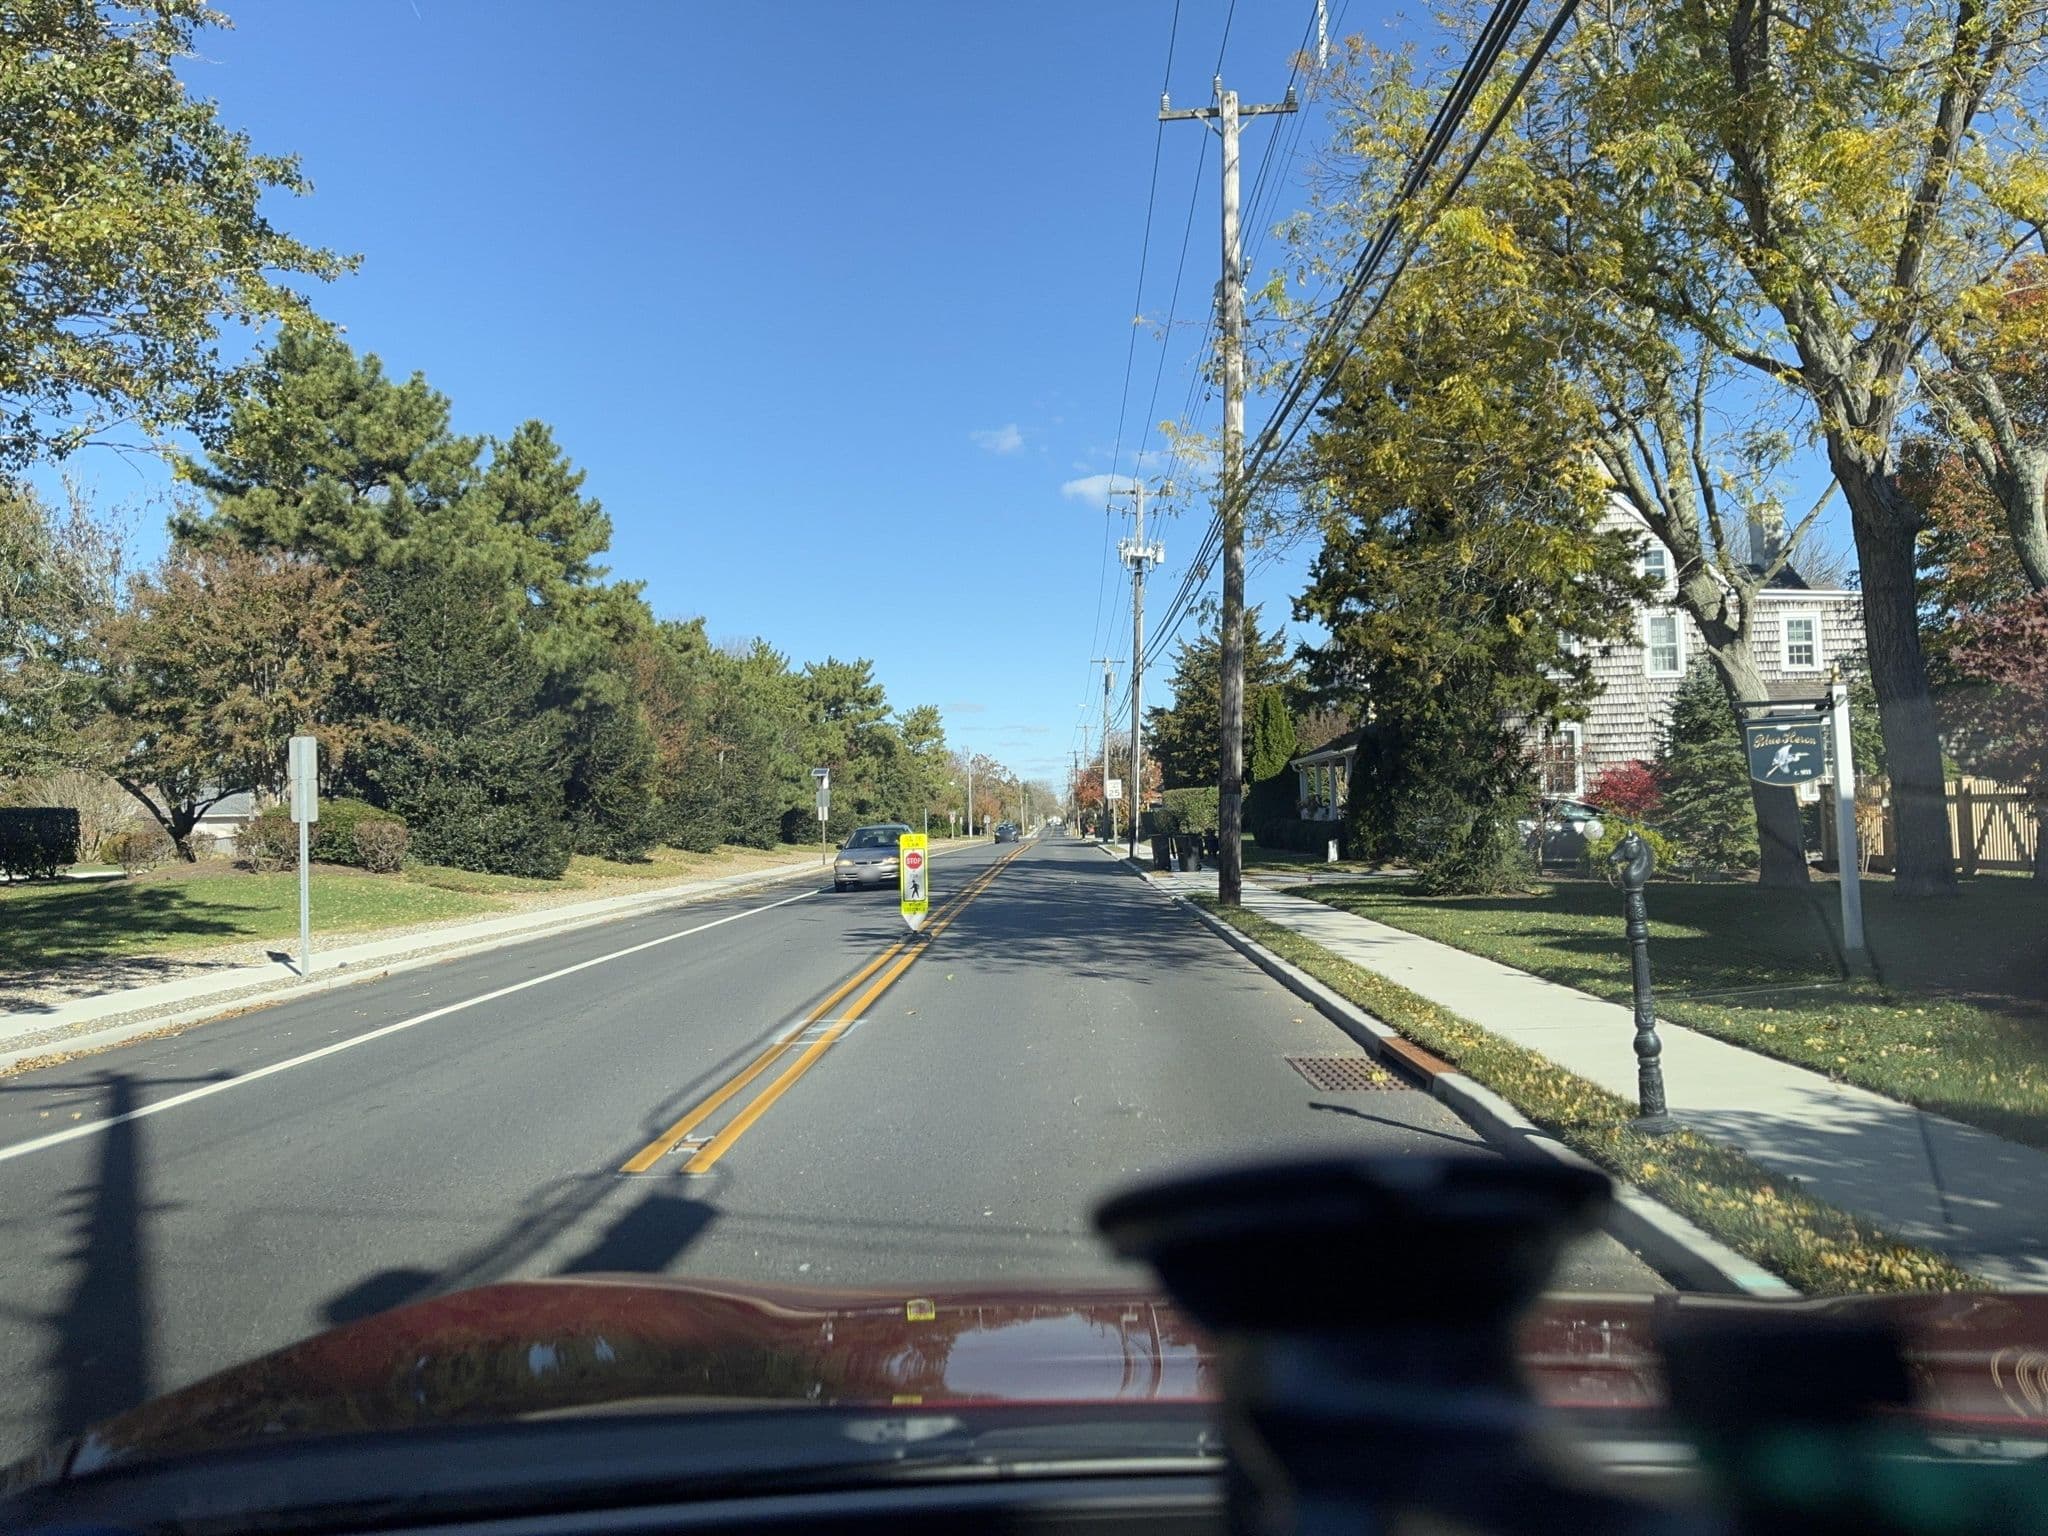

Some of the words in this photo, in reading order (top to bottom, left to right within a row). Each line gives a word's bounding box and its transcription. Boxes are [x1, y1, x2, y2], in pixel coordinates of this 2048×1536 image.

[1753, 734, 1780, 748] Blue
[1782, 731, 1816, 745] Heron
[906, 857, 922, 865] STOP
